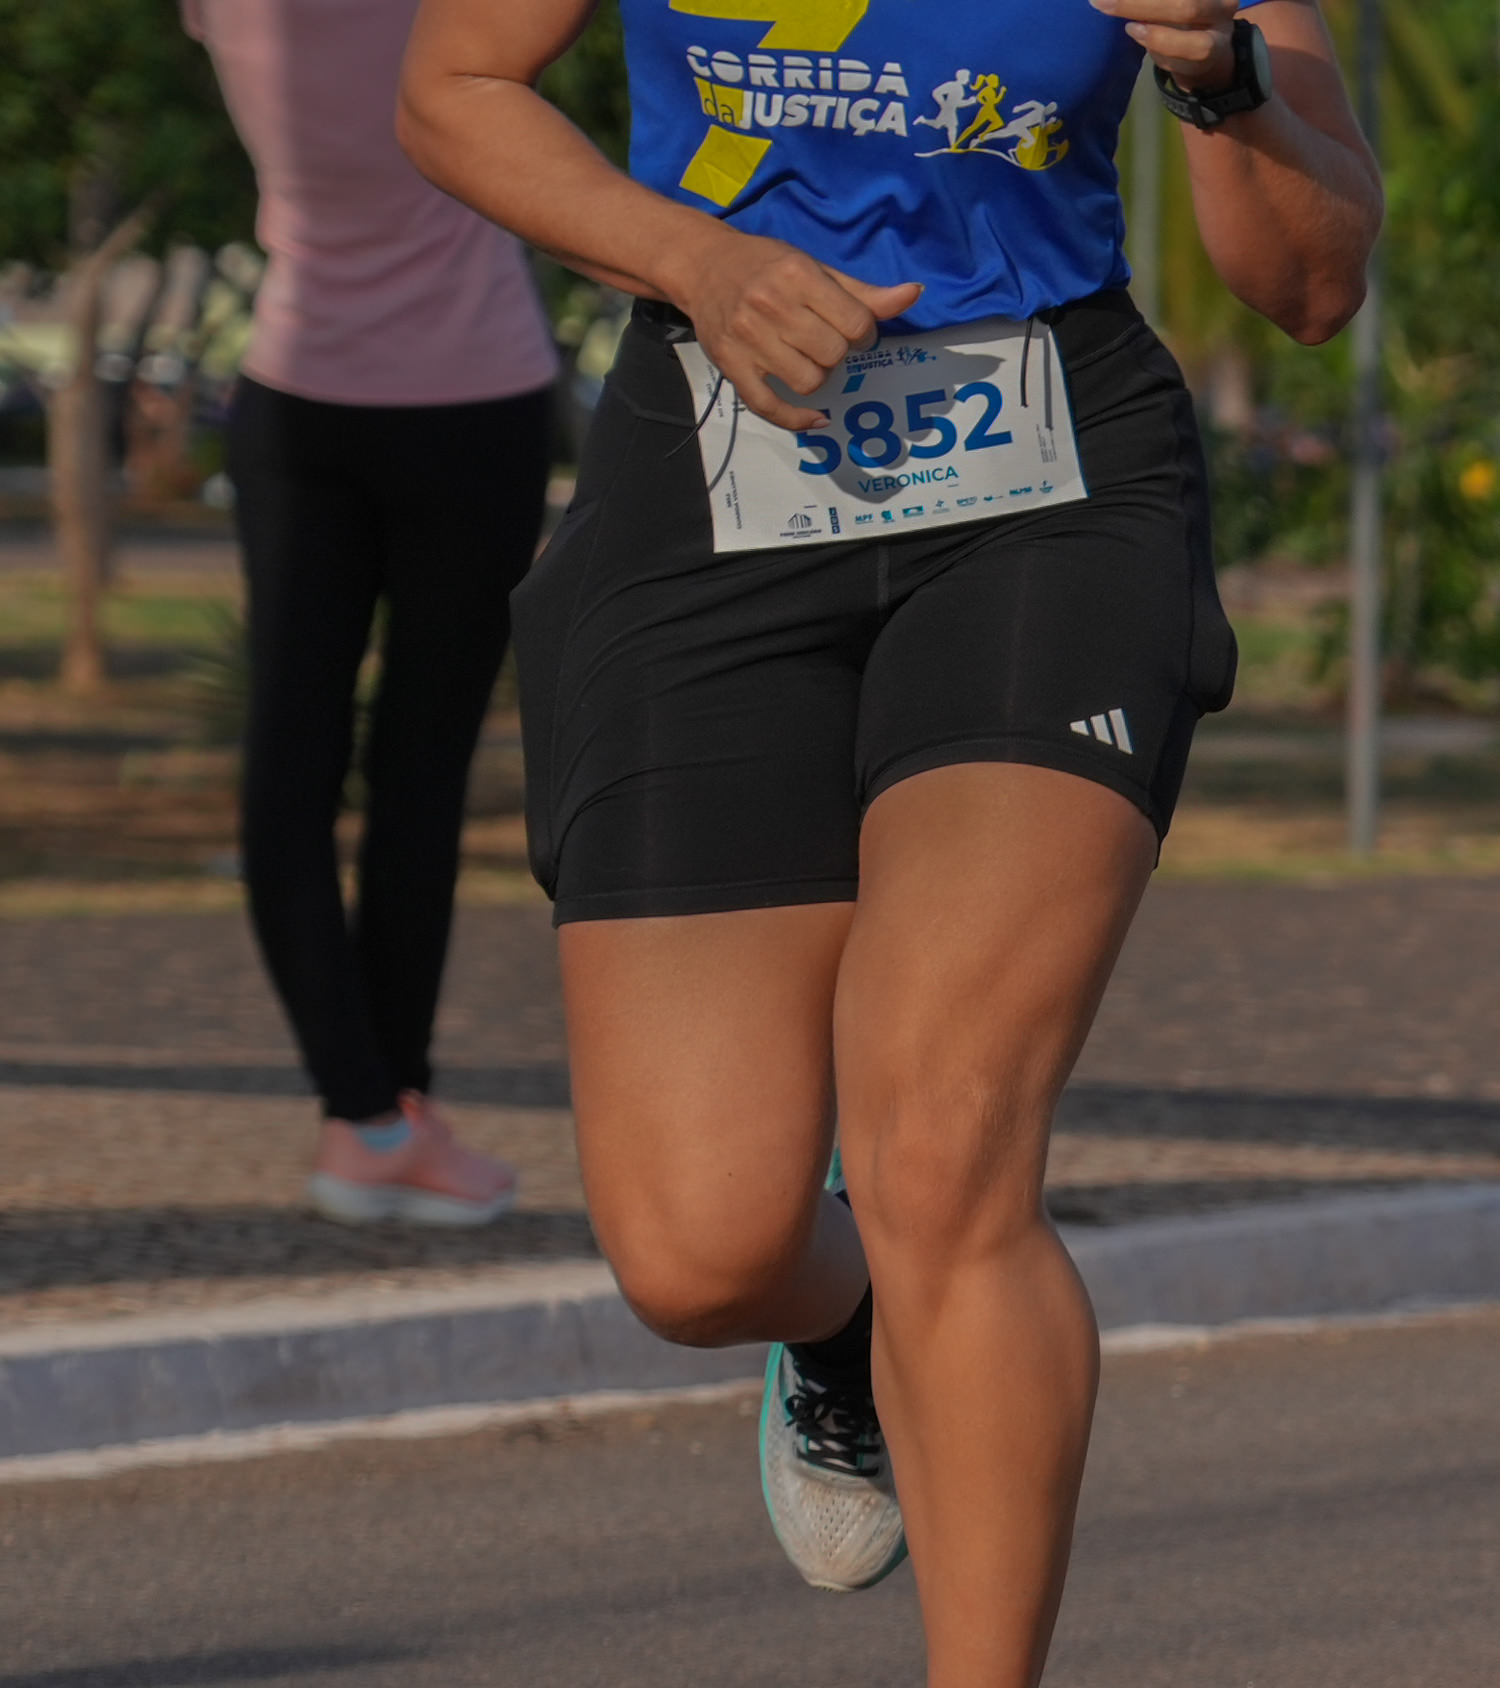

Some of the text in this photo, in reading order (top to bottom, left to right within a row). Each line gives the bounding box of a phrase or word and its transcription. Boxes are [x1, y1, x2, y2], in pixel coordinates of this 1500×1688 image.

[686, 45, 909, 97] CORRIDA
[735, 90, 908, 137] JUSTIÇA
[797, 381, 1013, 475] 5852
[858, 465, 959, 493] VERONICA
